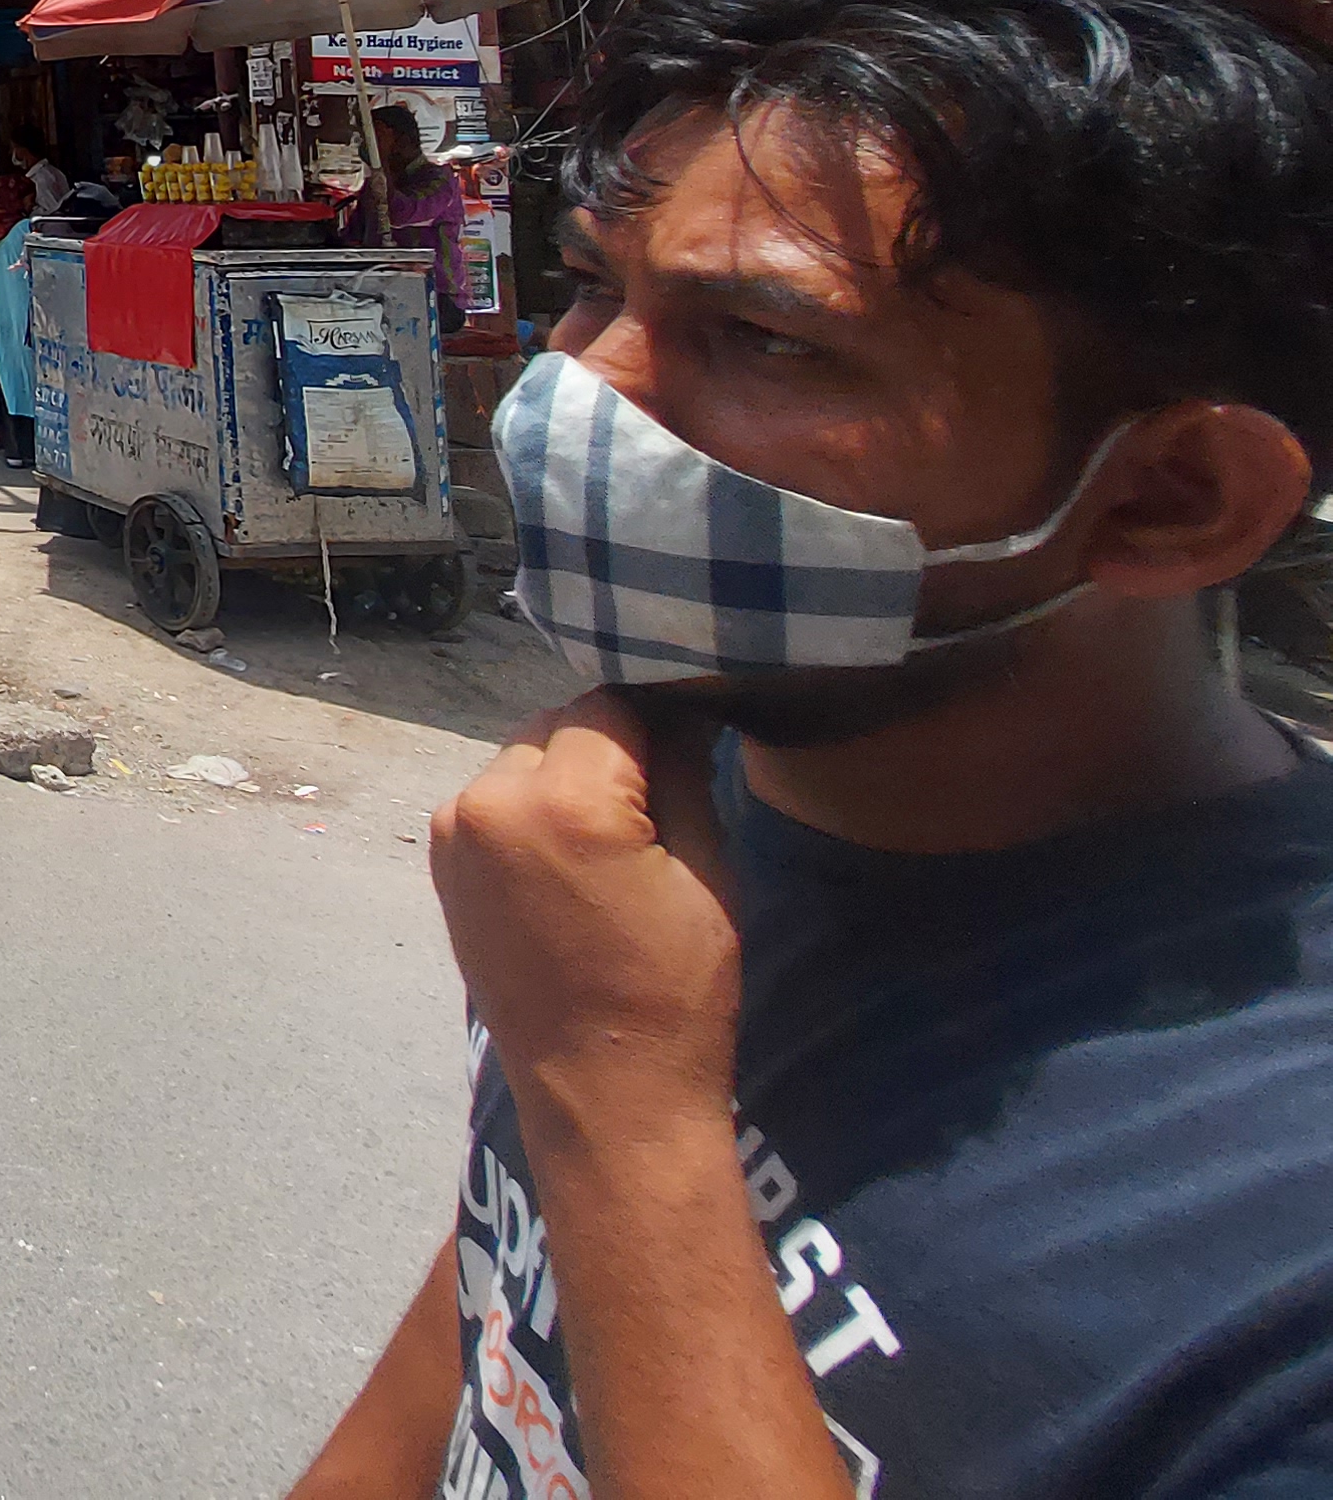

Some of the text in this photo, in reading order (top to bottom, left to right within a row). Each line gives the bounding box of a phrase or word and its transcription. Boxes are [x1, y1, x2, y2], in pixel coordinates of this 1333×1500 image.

[328, 33, 464, 52] Kep Hand Hygiene
[393, 67, 461, 80] District
